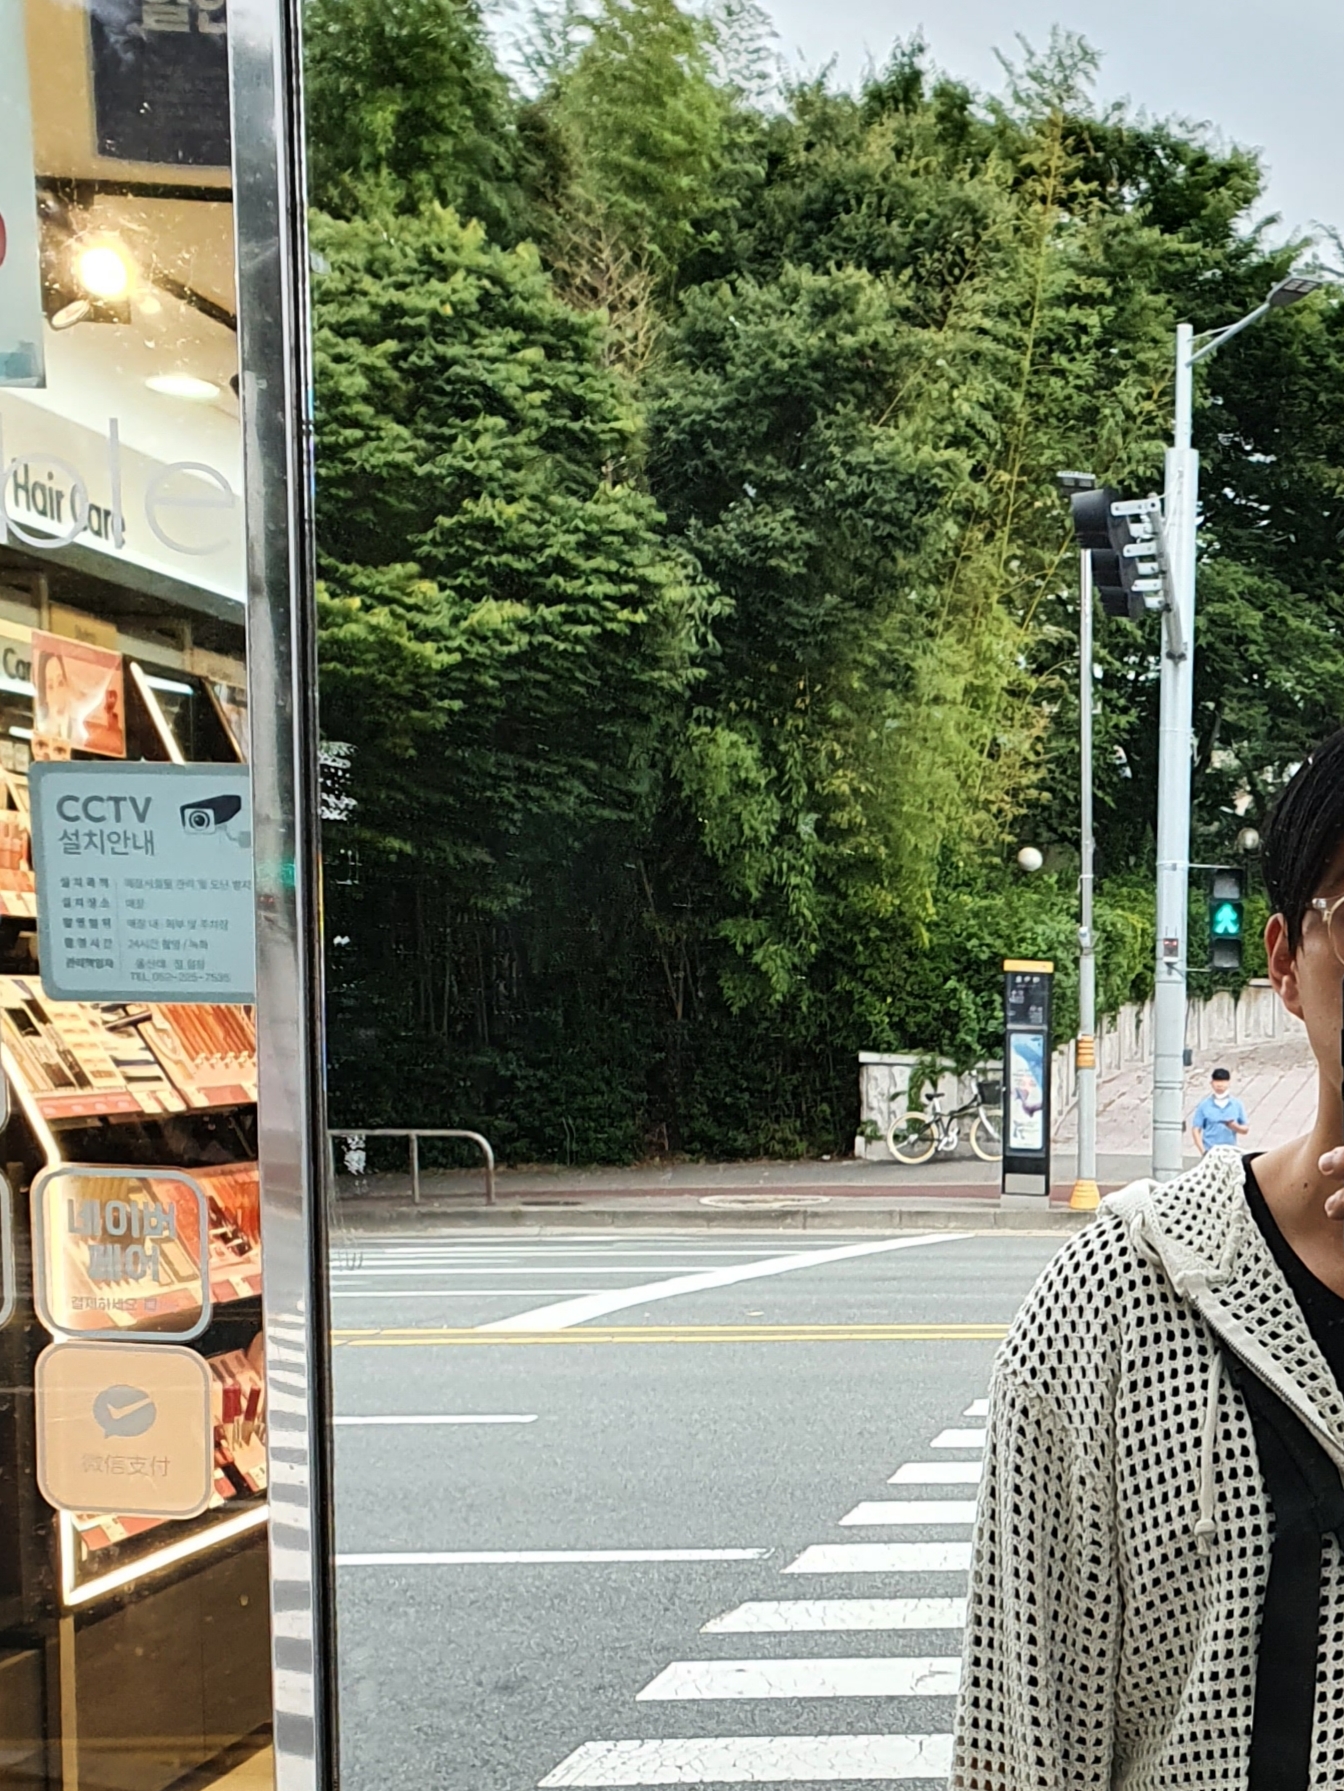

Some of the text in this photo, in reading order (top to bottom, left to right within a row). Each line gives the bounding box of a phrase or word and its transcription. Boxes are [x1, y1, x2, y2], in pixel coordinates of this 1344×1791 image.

[12, 458, 65, 524] Hair
[56, 794, 153, 823] CCTV
[58, 828, 156, 856] 설치안내
[67, 1198, 177, 1240] 네이버
[70, 1295, 138, 1312] 결제하세요
